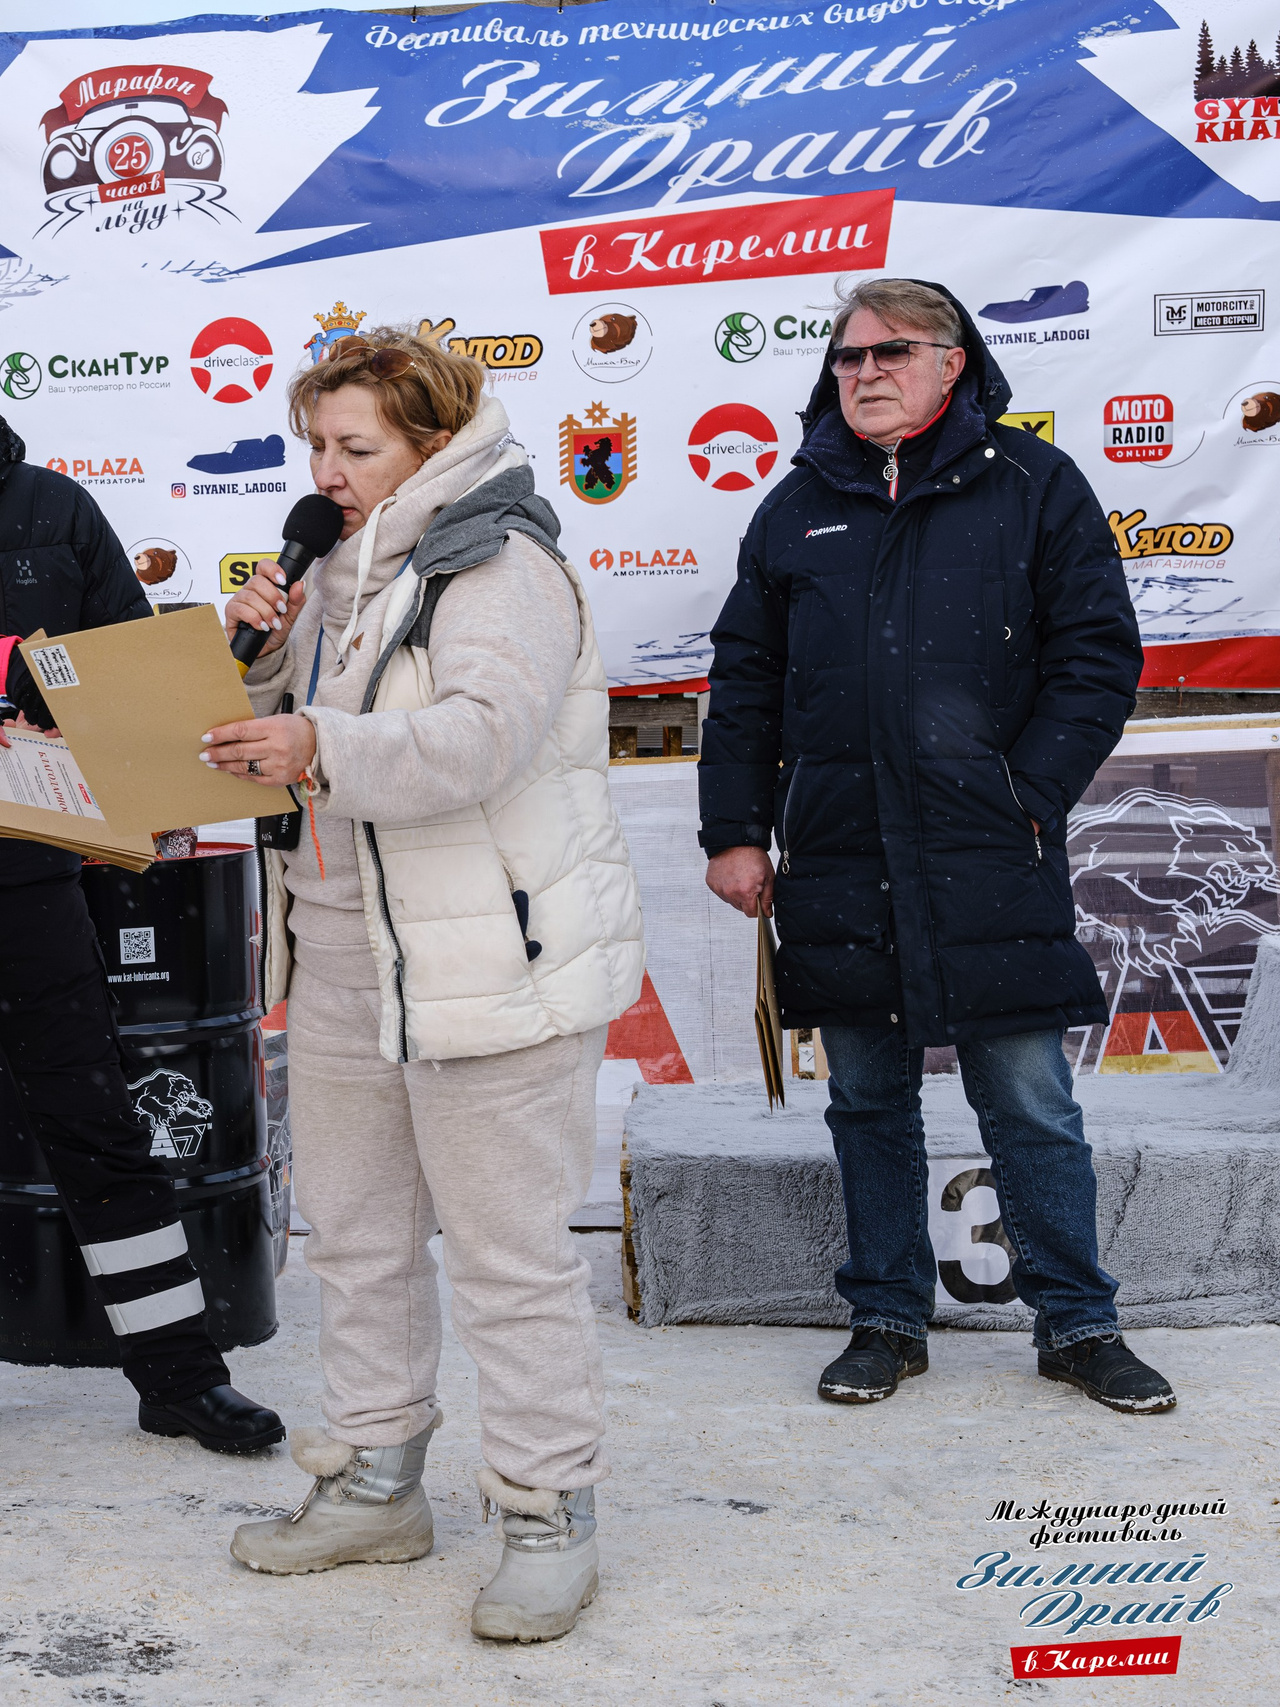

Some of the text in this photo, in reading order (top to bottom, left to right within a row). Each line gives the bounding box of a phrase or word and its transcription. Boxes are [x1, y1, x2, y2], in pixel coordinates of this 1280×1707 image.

[365, 18, 568, 51] Фестиваль
[578, 11, 814, 45] технических
[425, 26, 957, 127] Зимний
[75, 68, 197, 108] Марафон
[1194, 96, 1280, 121] GYM
[557, 79, 1017, 208] Драйв
[113, 140, 147, 171] 25
[105, 174, 162, 198] часов
[122, 200, 144, 212] на
[95, 203, 168, 234] льду
[563, 224, 873, 280] в Карелии
[1197, 300, 1248, 312] MOTORCITY
[1196, 315, 1255, 326] МЕСТО ВСТРЕЧИ
[984, 328, 1090, 346] SIYANIE_LADOGI
[773, 348, 793, 356] Ваш
[487, 371, 538, 382] ЗИНОВ
[48, 385, 66, 394] Ваш
[68, 383, 124, 394] туроператор
[139, 380, 171, 389] России
[1112, 399, 1165, 422] MOTO
[1112, 425, 1165, 445] RADIO
[73, 458, 144, 477] PLAZA
[193, 481, 287, 495] SIYANIE_LADOGI
[805, 524, 848, 538] FORWARD
[620, 548, 698, 568] PLAZA
[1132, 559, 1226, 570] МАГАЗИНОВ
[612, 568, 699, 577] АМОРТИЗАТОРЫ
[107, 971, 170, 983] www.kat-lubricants.org
[937, 1167, 1020, 1305] 3
